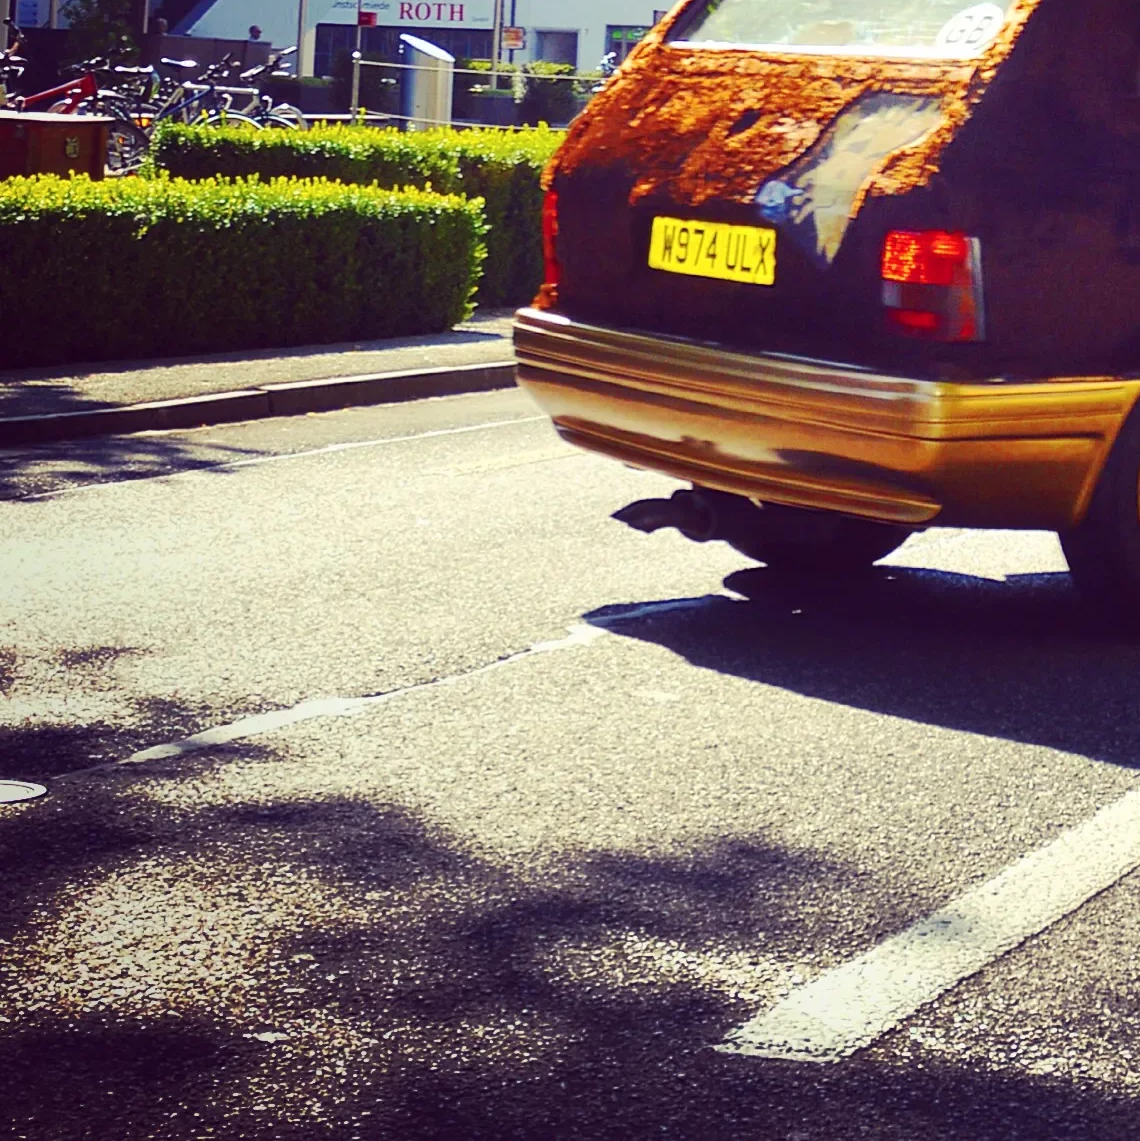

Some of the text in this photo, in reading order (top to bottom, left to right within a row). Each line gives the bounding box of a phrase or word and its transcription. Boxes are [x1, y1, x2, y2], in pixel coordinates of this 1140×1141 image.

[399, 2, 464, 21] ROTH
[945, 15, 993, 44] GB
[661, 225, 771, 276] W974 ULX
